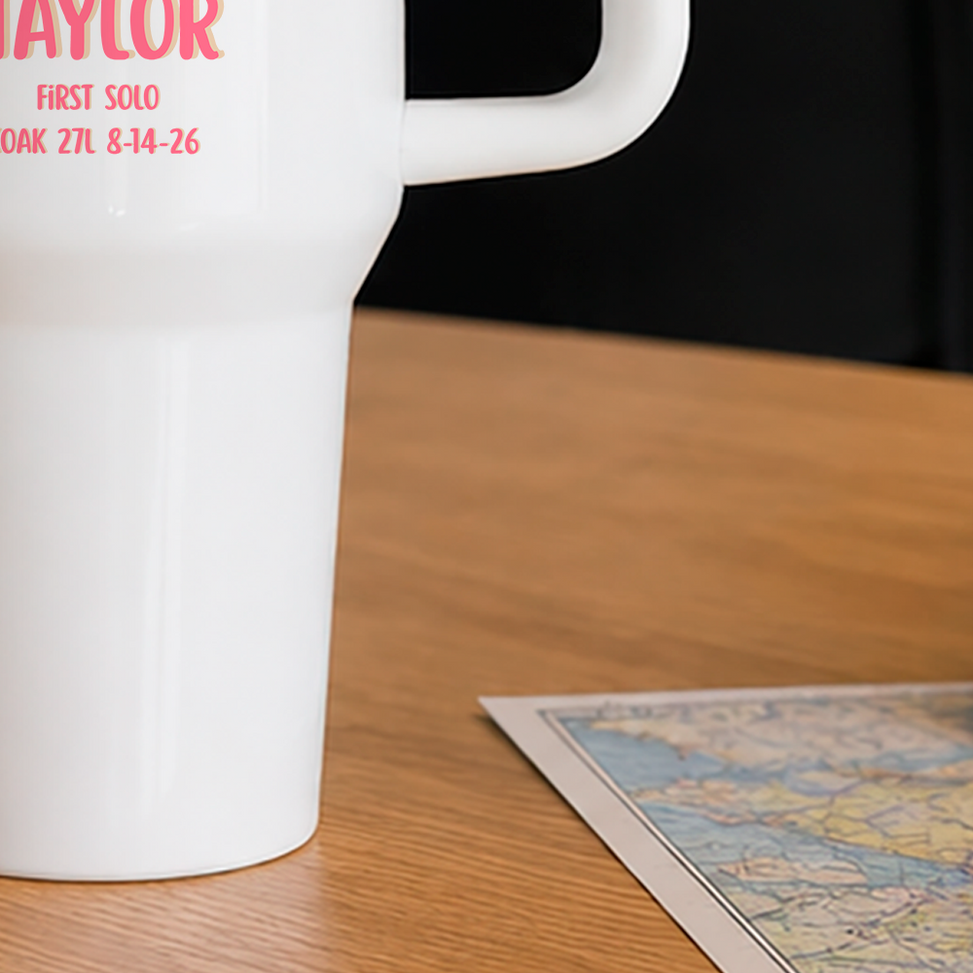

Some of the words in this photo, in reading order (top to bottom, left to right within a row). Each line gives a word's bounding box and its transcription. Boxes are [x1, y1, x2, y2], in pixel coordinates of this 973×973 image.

[104, 83, 160, 111] SOLO
[57, 127, 96, 155] 27L
[106, 127, 201, 155] 8-14-26
